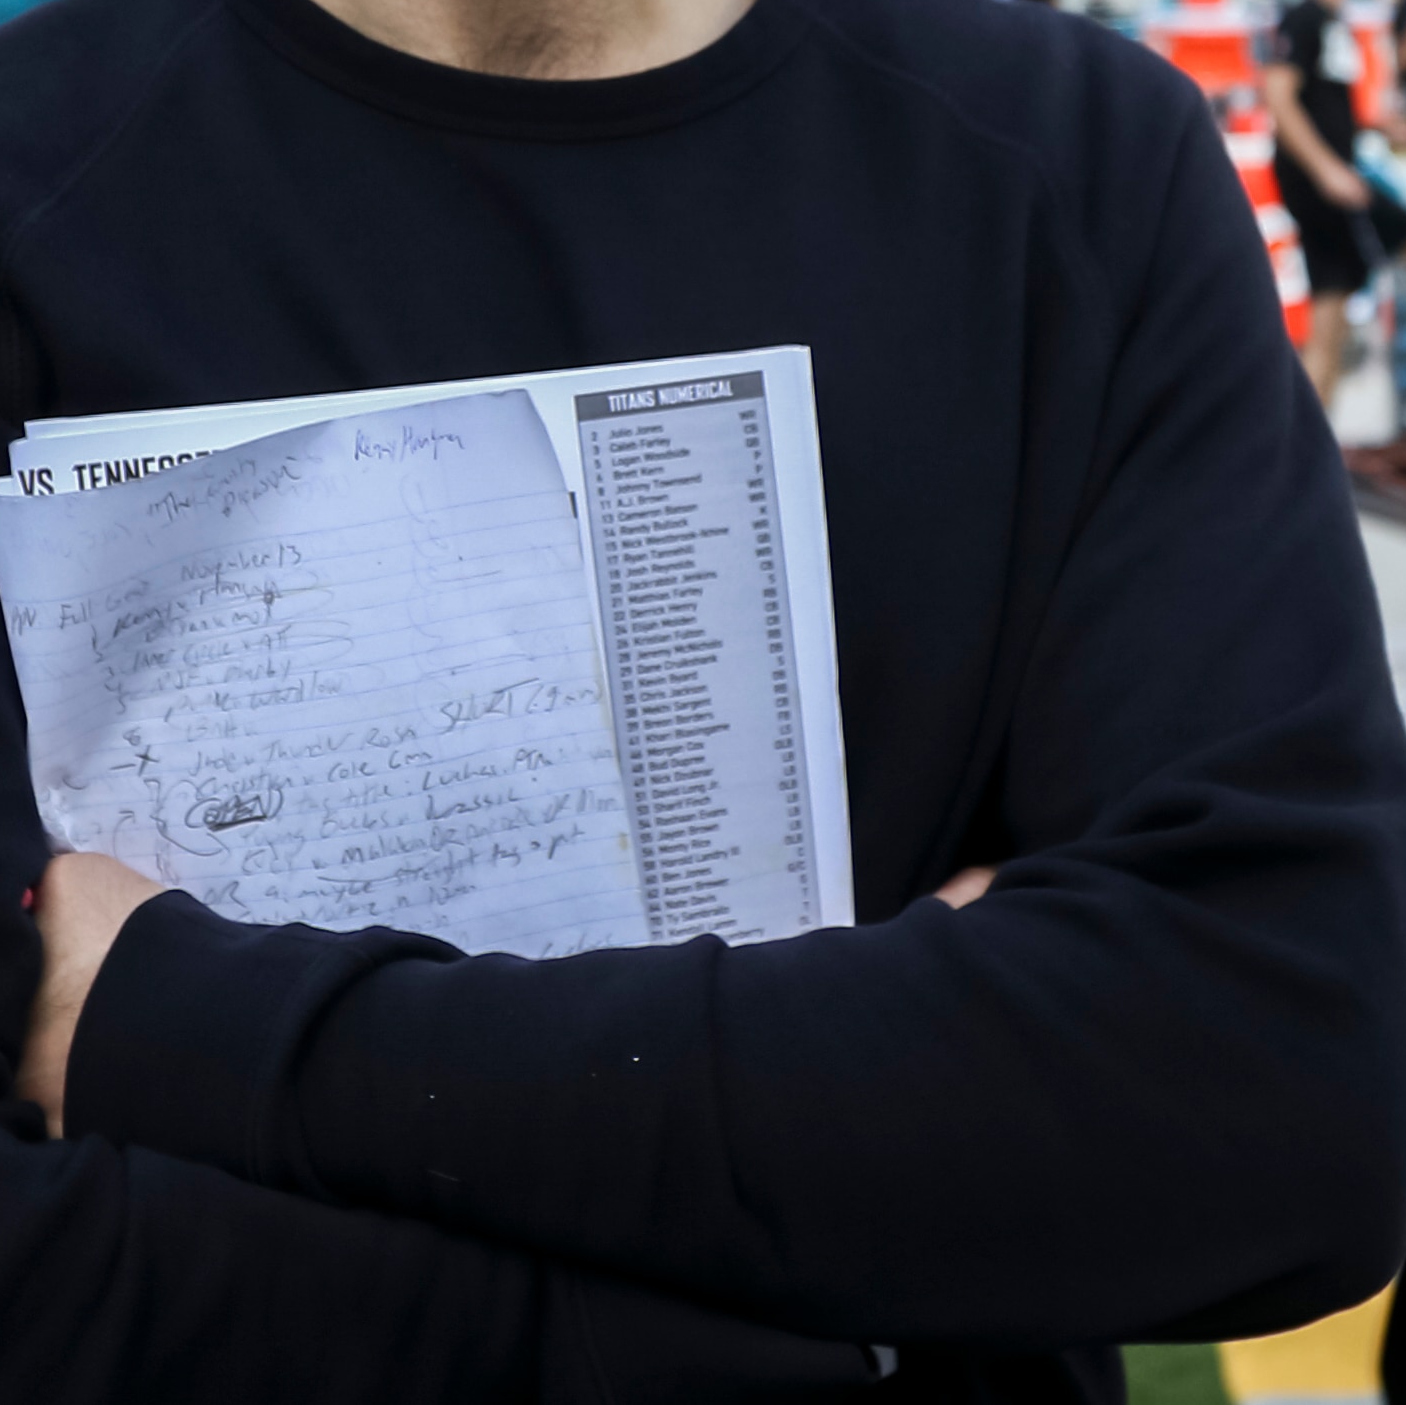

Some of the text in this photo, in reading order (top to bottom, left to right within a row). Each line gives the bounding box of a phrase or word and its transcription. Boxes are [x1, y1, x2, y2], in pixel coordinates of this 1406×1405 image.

[606, 380, 734, 413] TITANS NUMERICAL
[18, 467, 55, 496] VS
